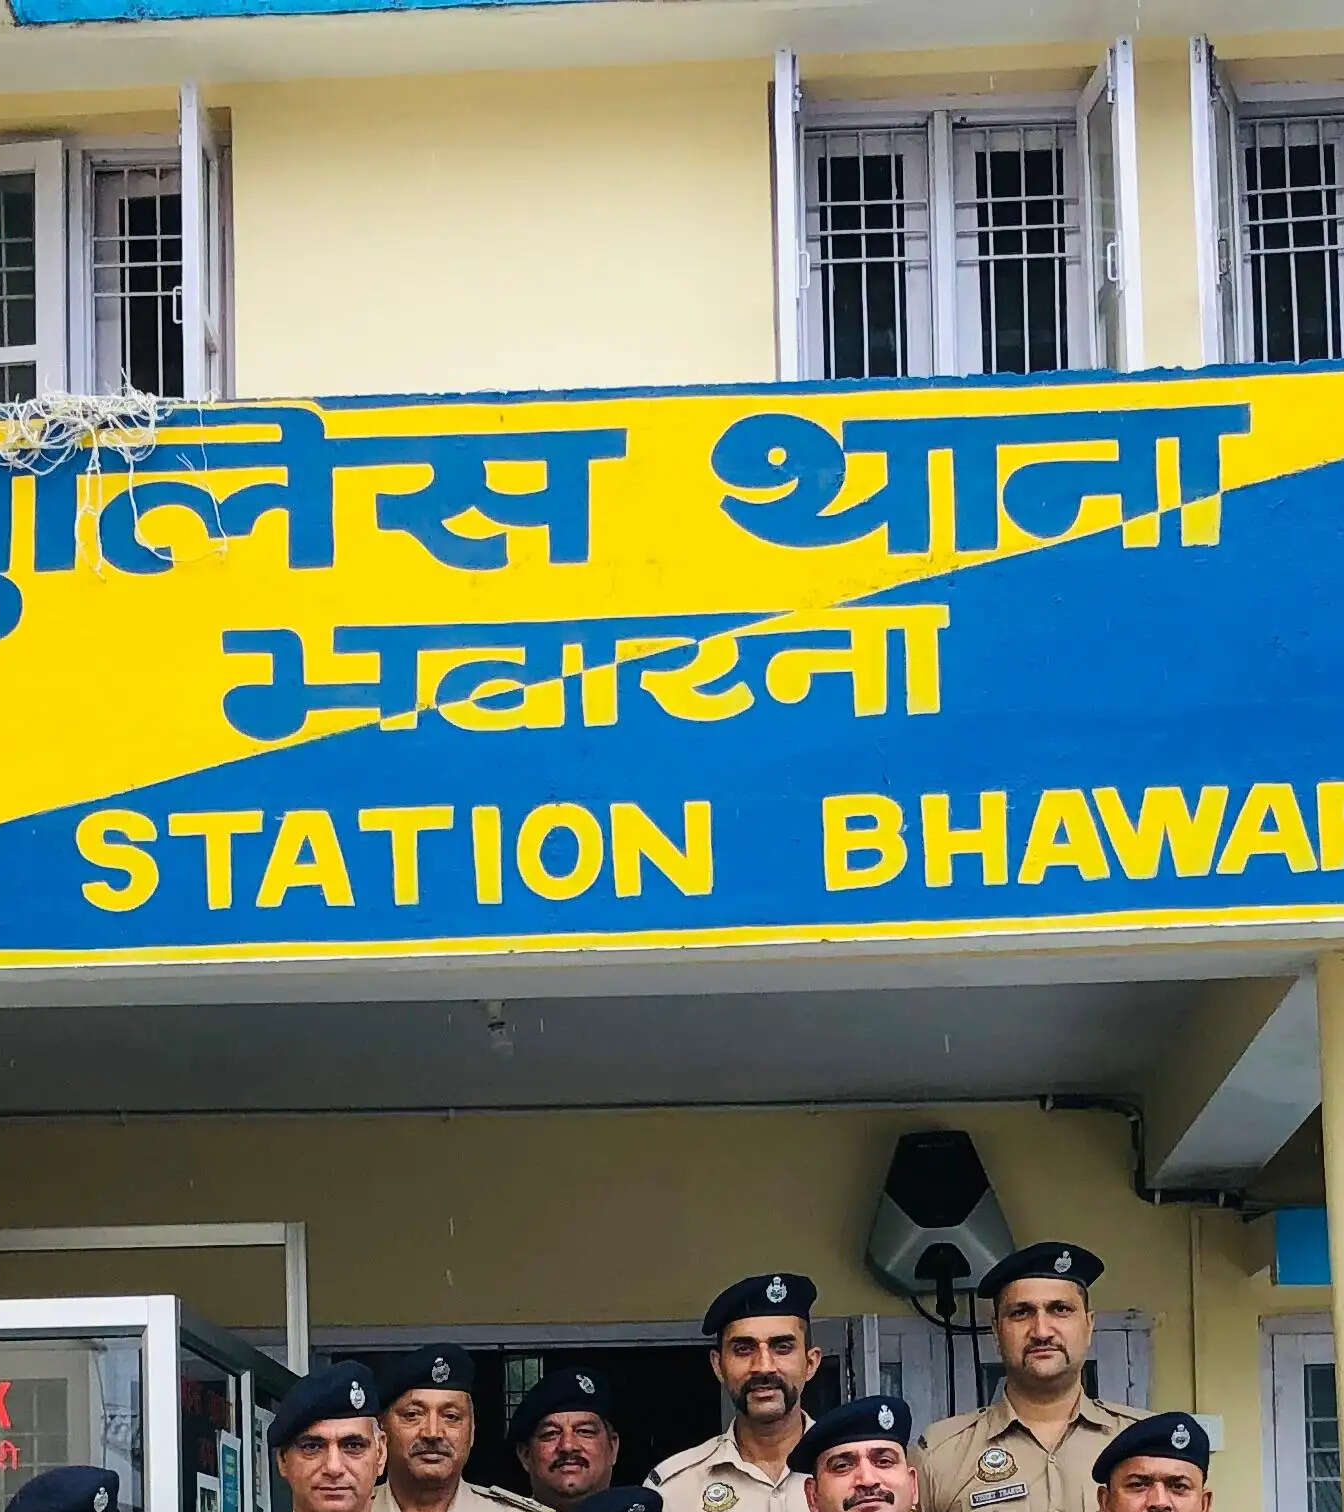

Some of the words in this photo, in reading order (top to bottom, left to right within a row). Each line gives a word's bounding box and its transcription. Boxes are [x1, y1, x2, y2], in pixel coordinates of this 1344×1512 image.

[711, 402, 1251, 556] थाना
[221, 604, 951, 741] भवारना
[73, 800, 714, 912] STATION
